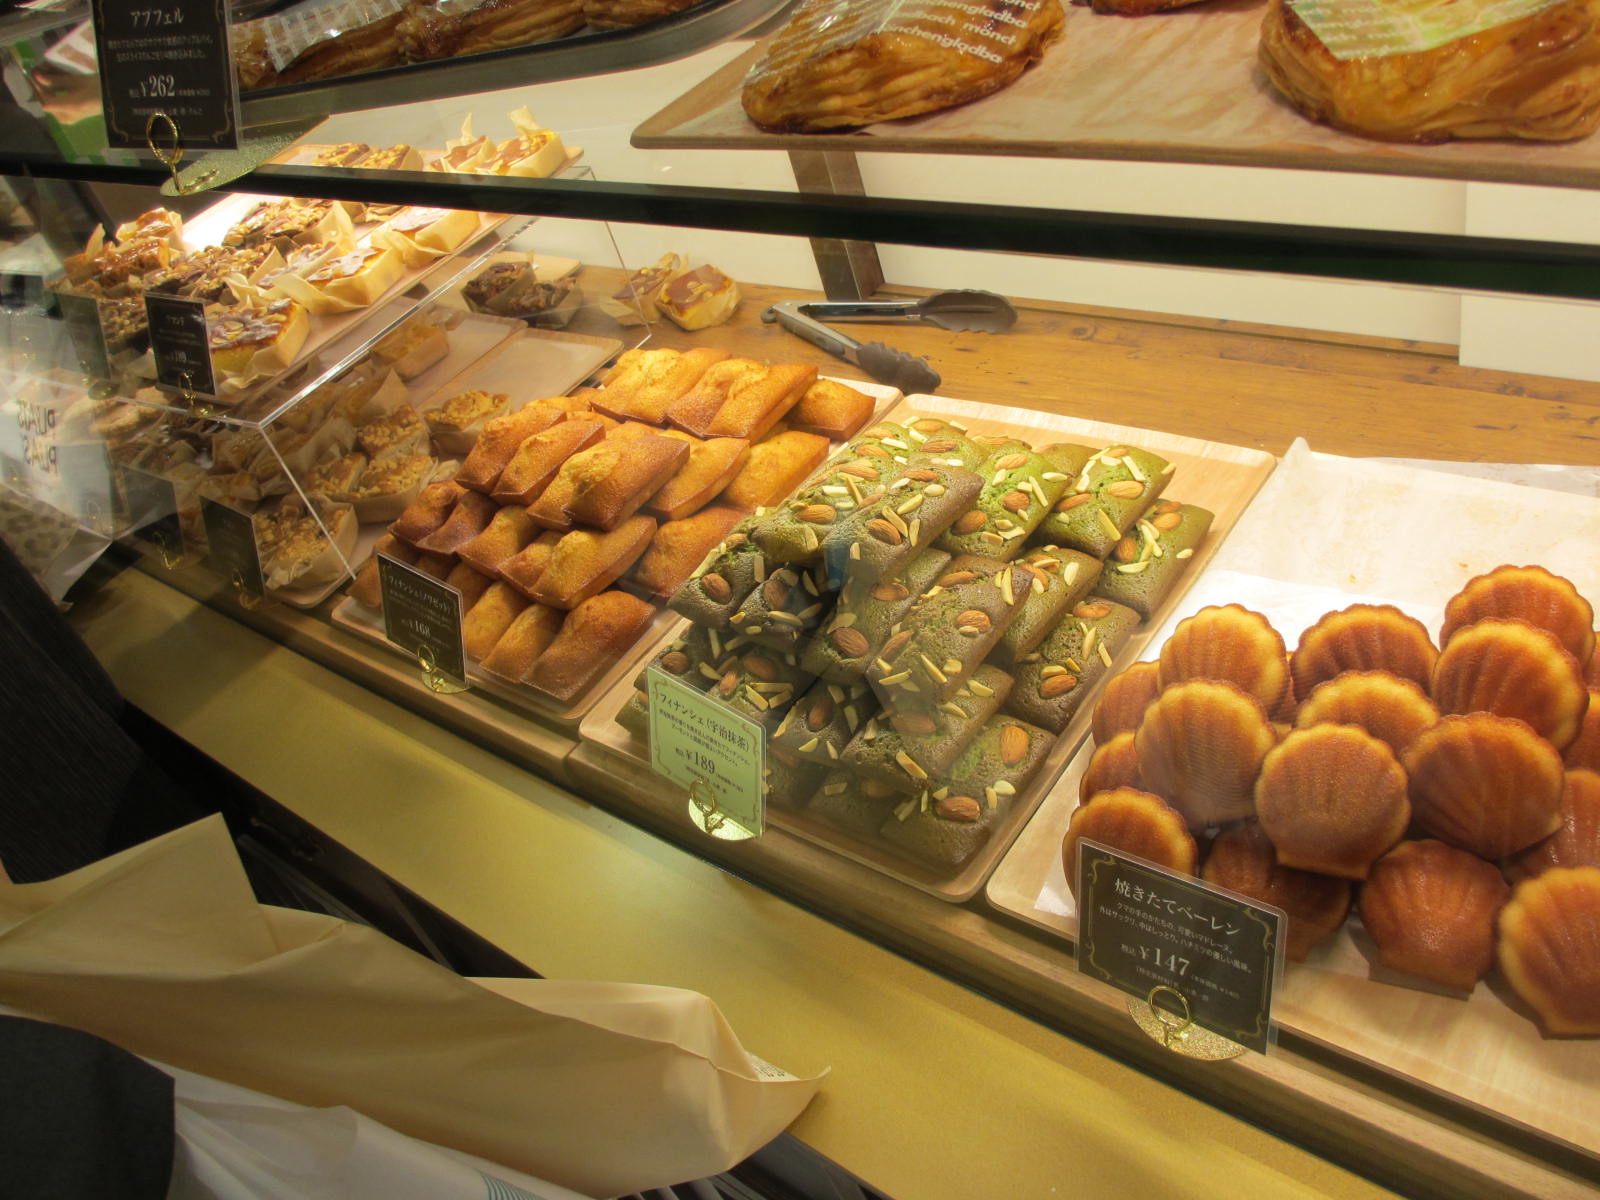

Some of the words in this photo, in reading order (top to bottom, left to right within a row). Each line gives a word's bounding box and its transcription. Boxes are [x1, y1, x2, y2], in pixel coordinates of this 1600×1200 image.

[1114, 878, 1240, 935] 焼きたてベーレン
